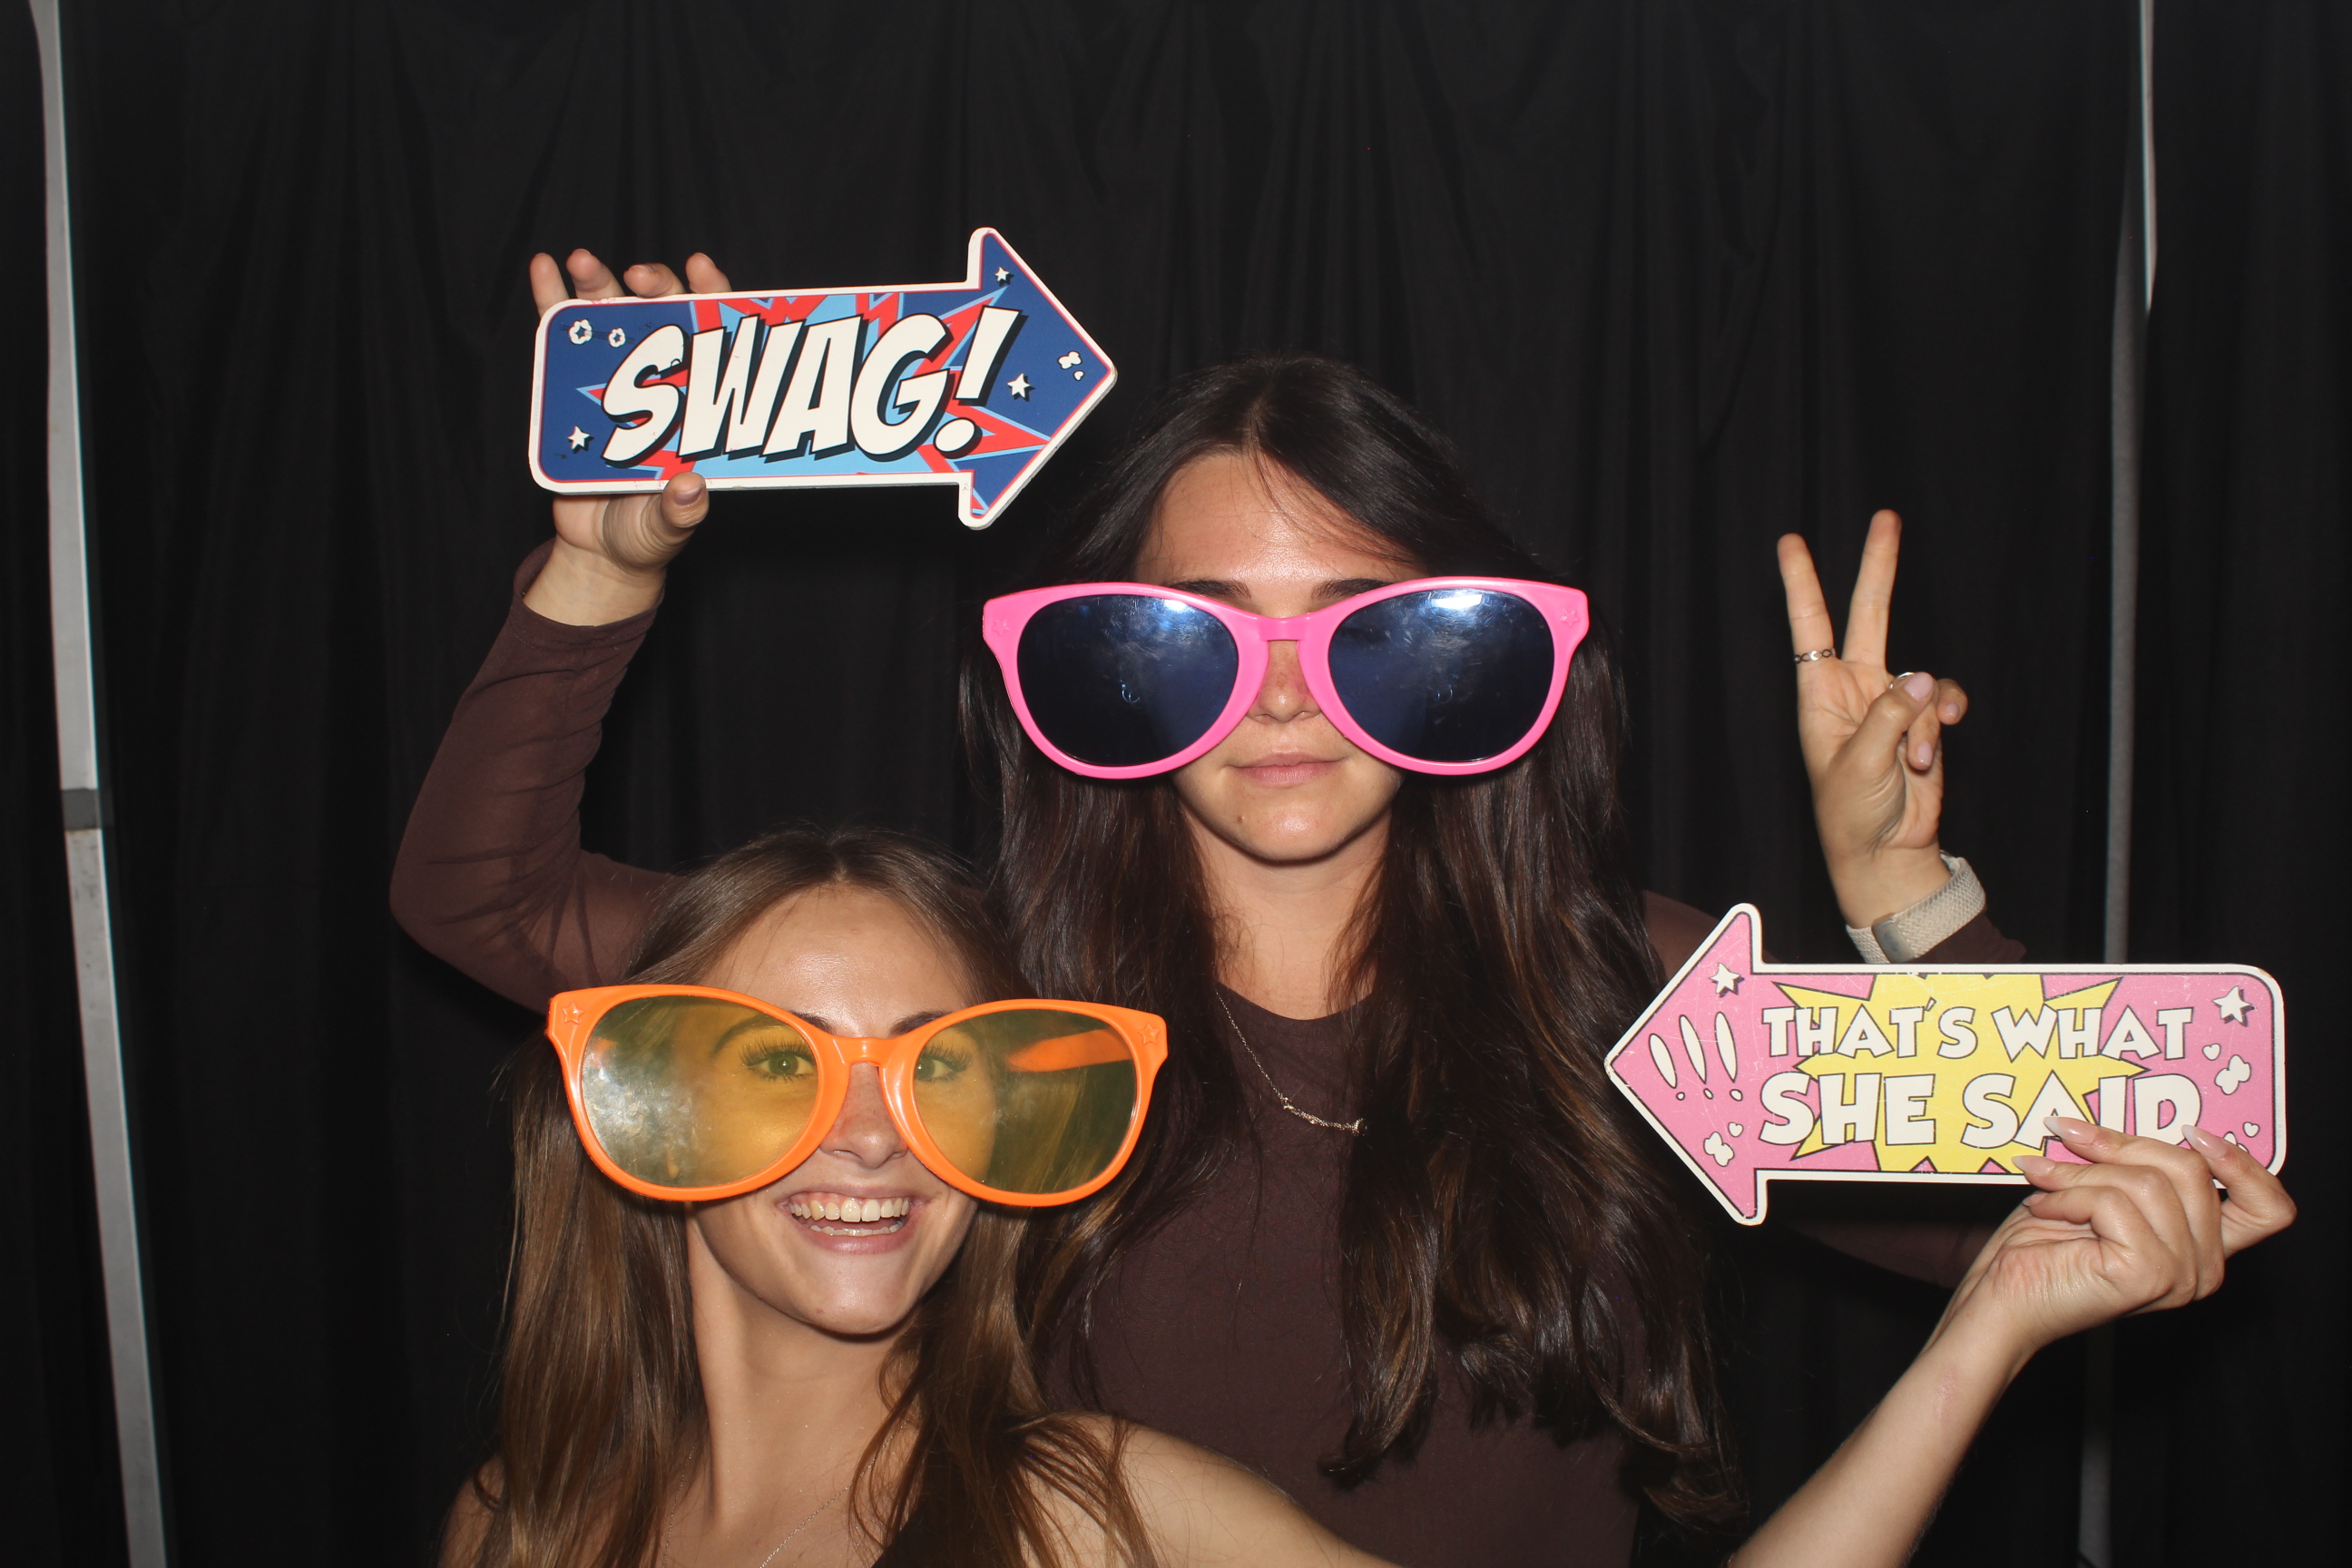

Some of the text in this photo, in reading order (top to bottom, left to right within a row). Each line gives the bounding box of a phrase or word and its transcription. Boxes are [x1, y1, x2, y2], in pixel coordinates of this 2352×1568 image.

[602, 305, 1023, 466] SWAG!
[1759, 997, 2194, 1063] THAT'S WHAT
[1758, 1072, 1936, 1146] SHE
[1959, 1070, 2203, 1150] SAID
